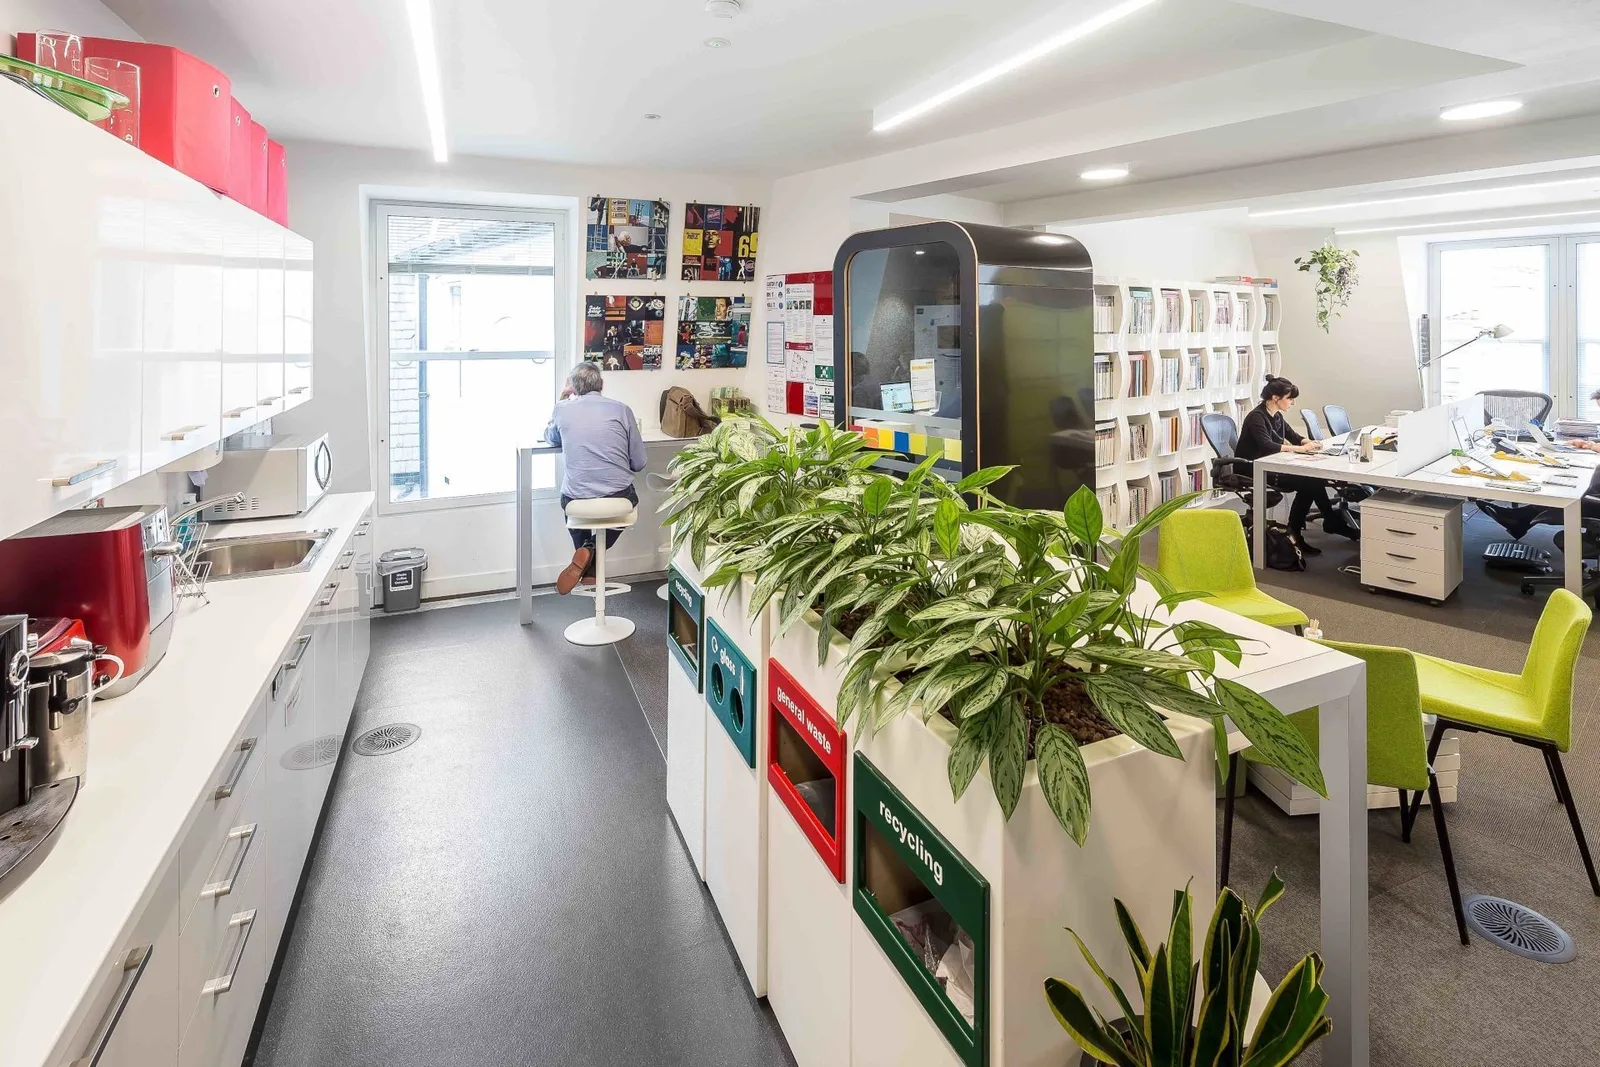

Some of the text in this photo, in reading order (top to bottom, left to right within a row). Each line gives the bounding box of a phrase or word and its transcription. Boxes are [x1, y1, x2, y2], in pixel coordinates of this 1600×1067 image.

[675, 580, 693, 608] recycling
[719, 646, 736, 676] glass
[777, 687, 832, 754] general waste
[879, 800, 943, 886] recycling
